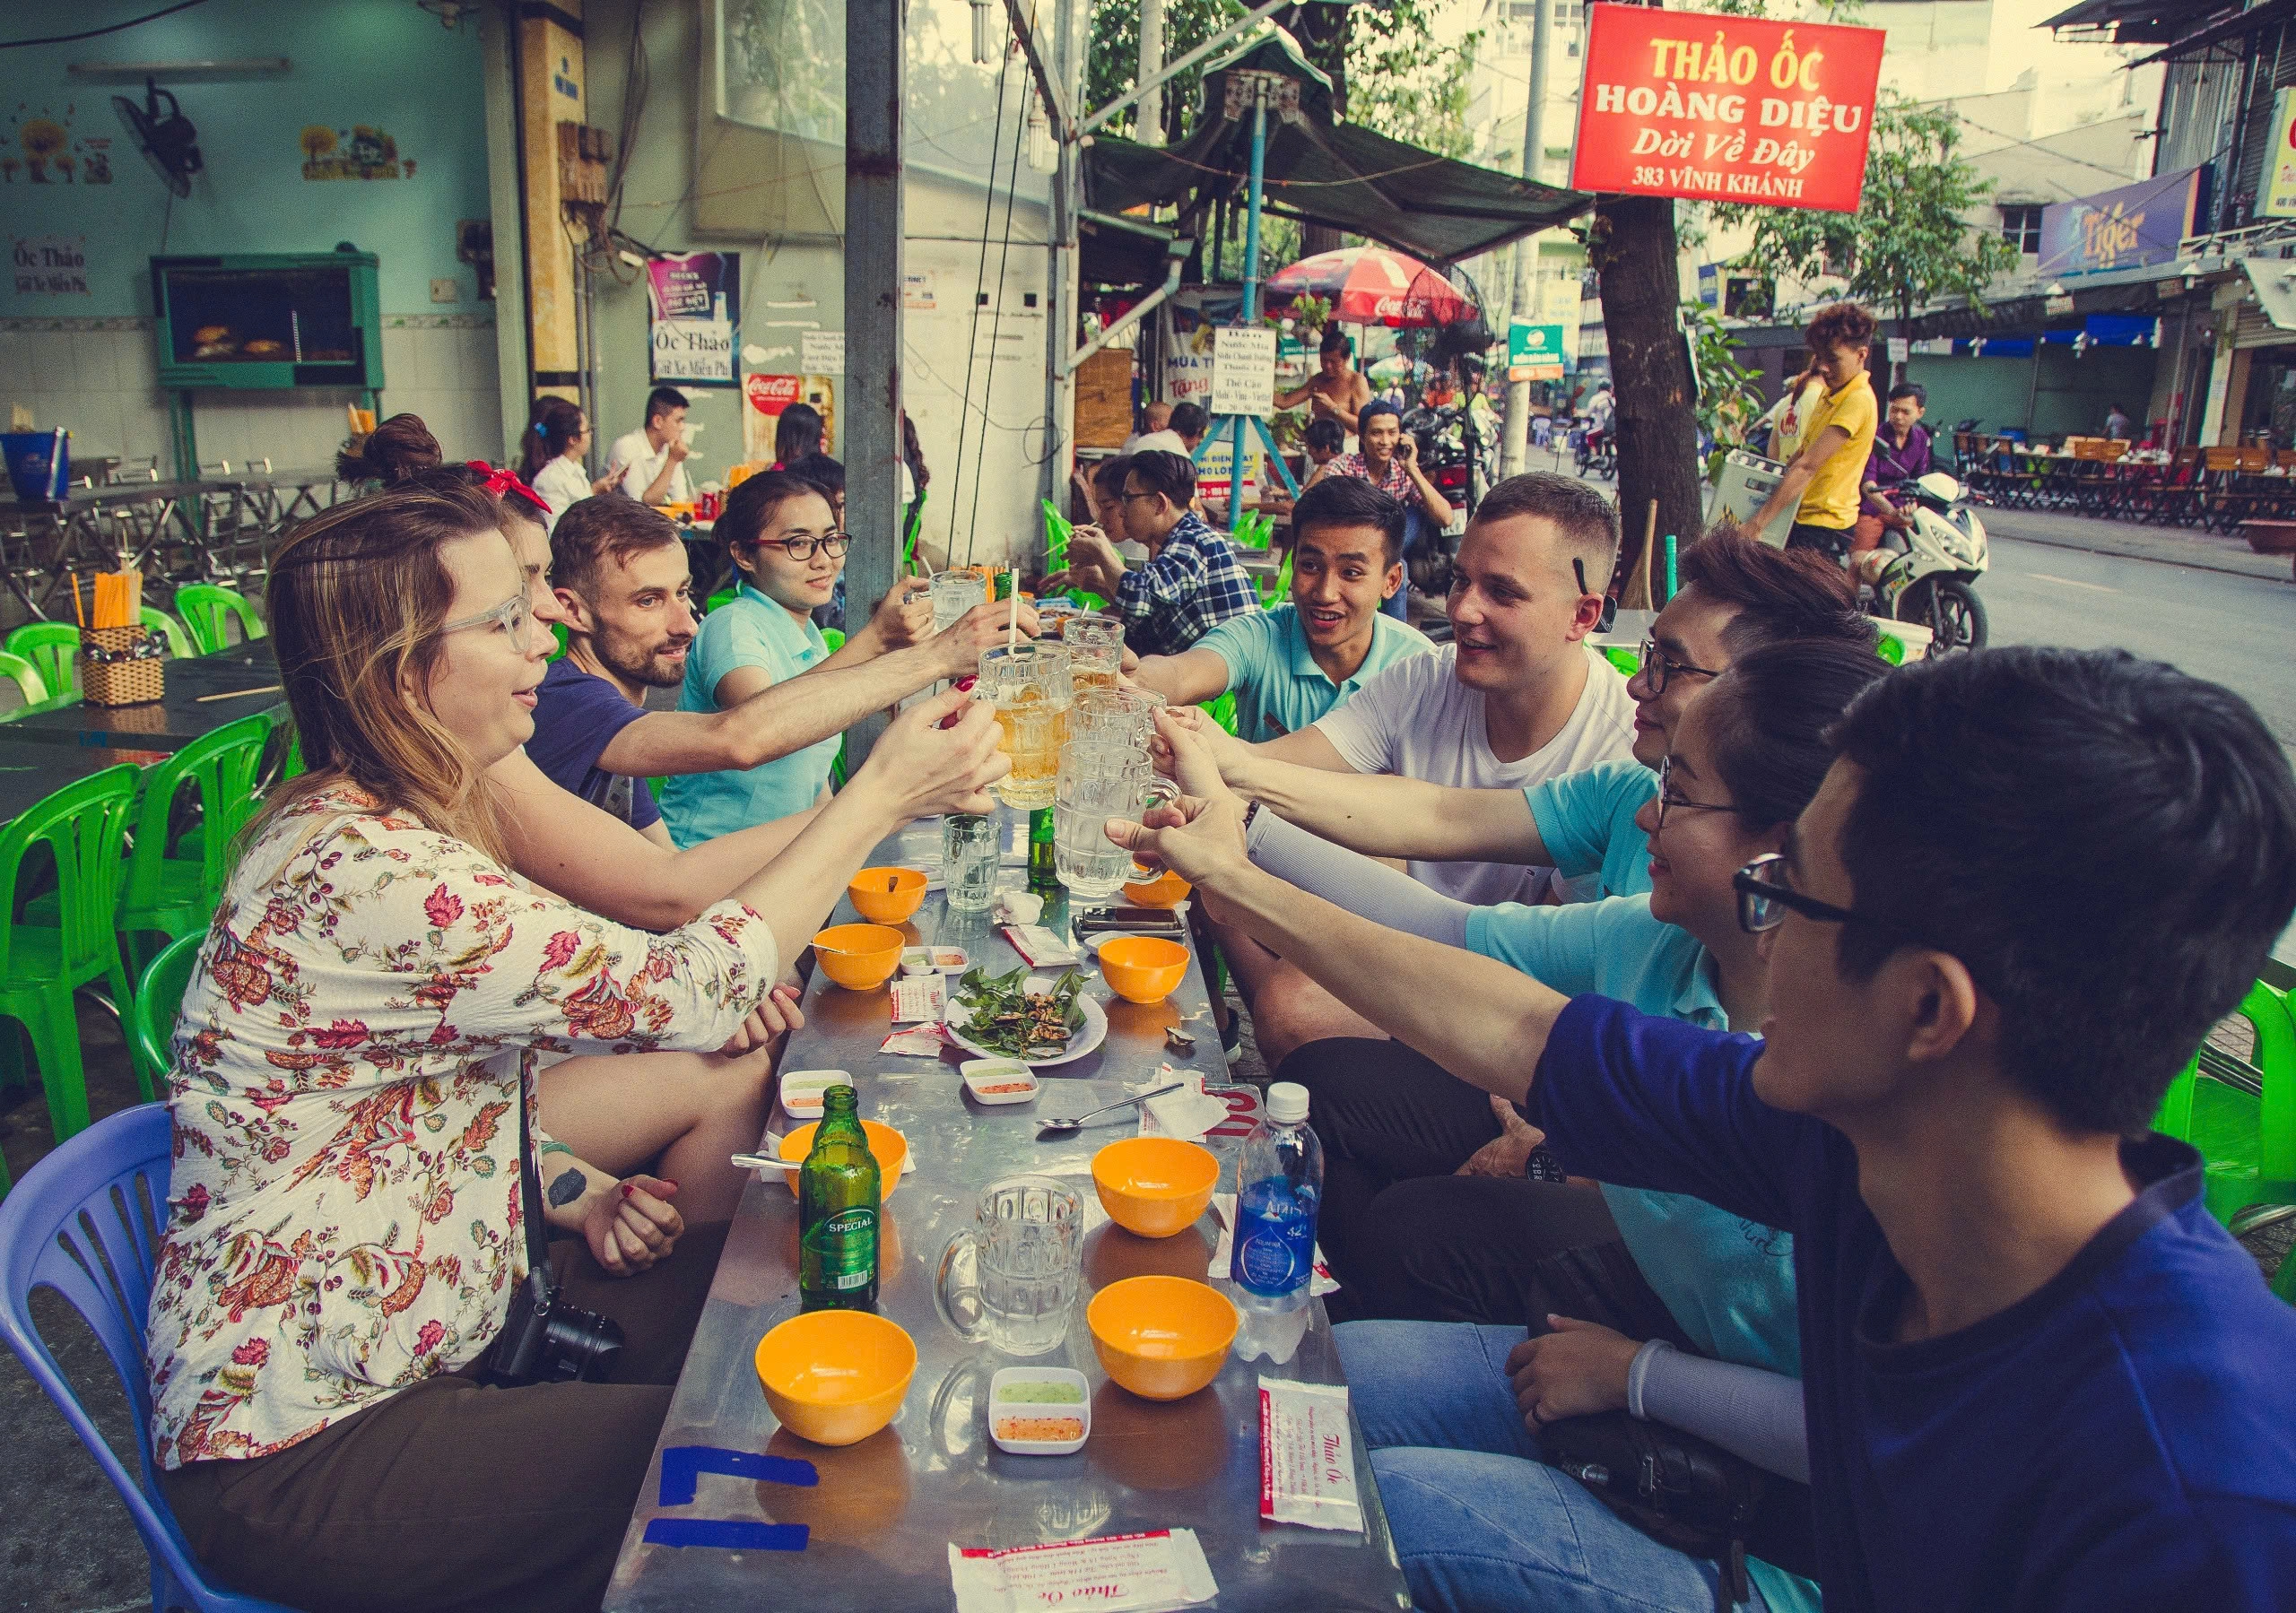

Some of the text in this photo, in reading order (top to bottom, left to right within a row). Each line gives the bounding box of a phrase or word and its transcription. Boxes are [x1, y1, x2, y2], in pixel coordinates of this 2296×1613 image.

[1648, 28, 1824, 92] THẢO ỐC
[1595, 81, 1863, 138] HOÀNG DIỆU
[1631, 126, 1816, 175] Dời Về Đây
[1631, 165, 1805, 198] 383 VĨNH KHÁNH
[2082, 201, 2146, 269] Tiger
[656, 325, 730, 351] Ốc Thảo
[747, 377, 796, 396] Coca-Cola
[829, 1217, 873, 1232] SPECIAL
[1322, 1433, 1351, 1485] Thảo Ốc
[1072, 1583, 1130, 1600] Thảo
